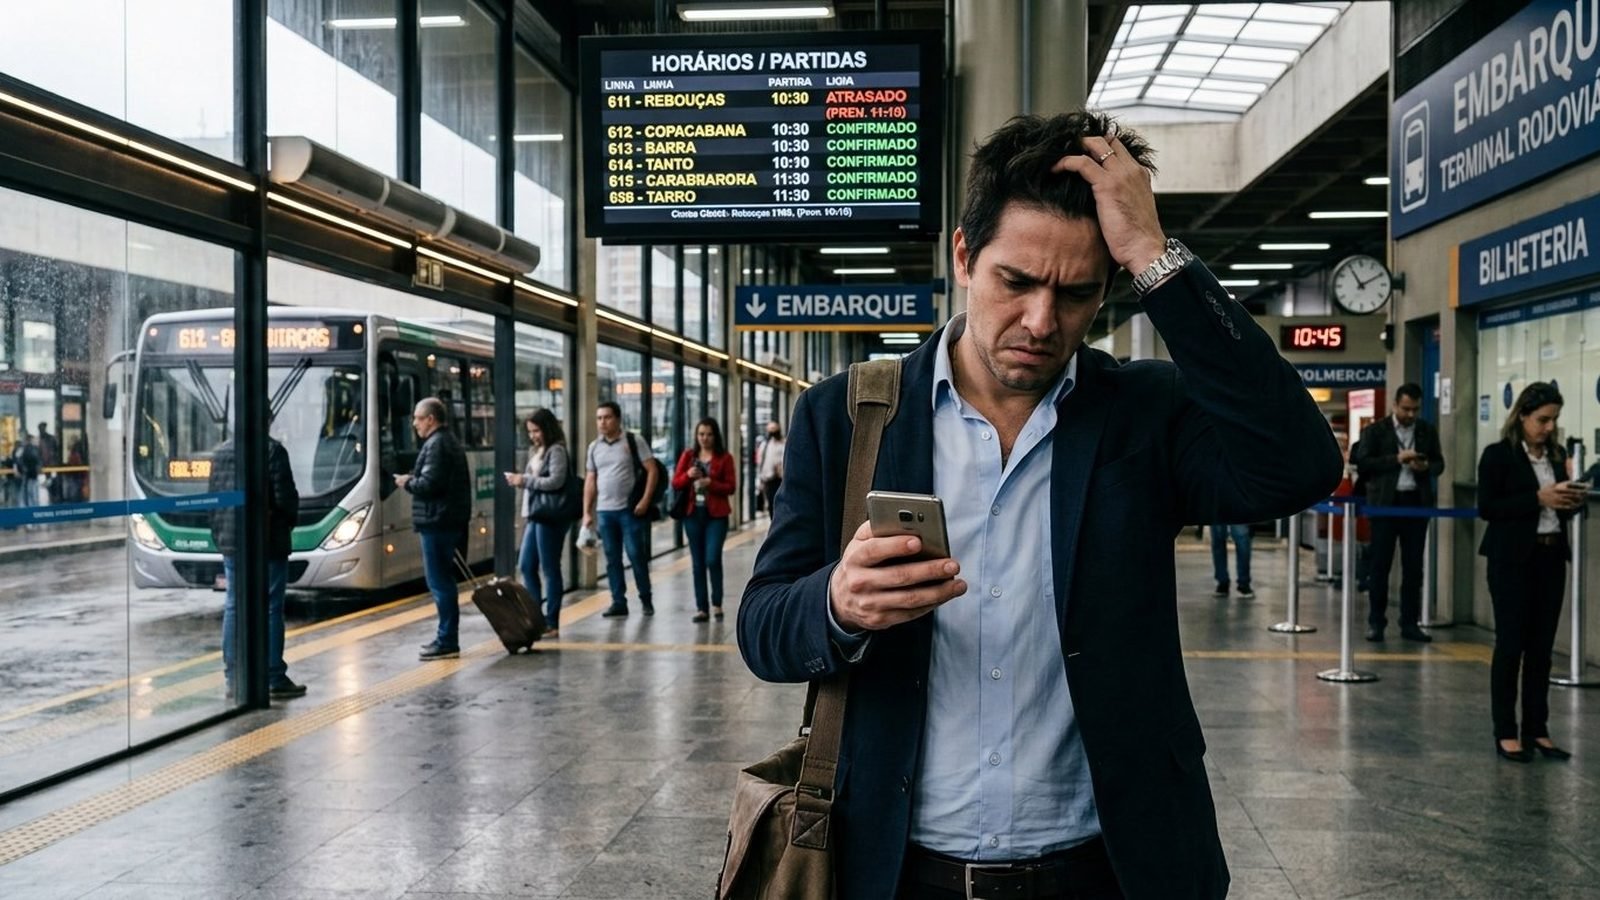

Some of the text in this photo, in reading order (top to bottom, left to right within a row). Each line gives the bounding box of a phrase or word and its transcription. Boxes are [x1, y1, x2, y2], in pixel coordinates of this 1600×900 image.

[652, 51, 867, 72] HORÁRIOS / PARTIDAS
[768, 76, 812, 87] PARTIRA
[607, 95, 631, 108] 611
[644, 93, 726, 110] REBOUÇAS
[771, 92, 810, 105] 10:30
[826, 90, 907, 104] ATRASADO
[607, 125, 634, 139] 612
[644, 124, 747, 138] COPACABANA
[772, 123, 810, 136] 10:30
[826, 122, 917, 135] CONFIRMADO
[607, 142, 634, 155] 613
[645, 141, 697, 155] BARRA
[772, 140, 810, 153] 10:30
[826, 138, 918, 152] CONFIRMADO
[608, 158, 634, 172] 614
[645, 157, 695, 171] TANTO
[826, 155, 918, 168] CONFIRMADO
[1440, 127, 1515, 192] TERMINAL
[645, 173, 758, 187] CARABRARORA
[773, 173, 810, 186] 11:30
[826, 171, 918, 185] CONFIRMADO
[646, 190, 697, 203] TARRO
[773, 189, 810, 202] 11:30
[826, 188, 918, 201] CONFIRMADO
[1479, 217, 1589, 286] BILHETERIA
[777, 294, 917, 319] EMBARQUE
[1294, 327, 1341, 346] 10:45
